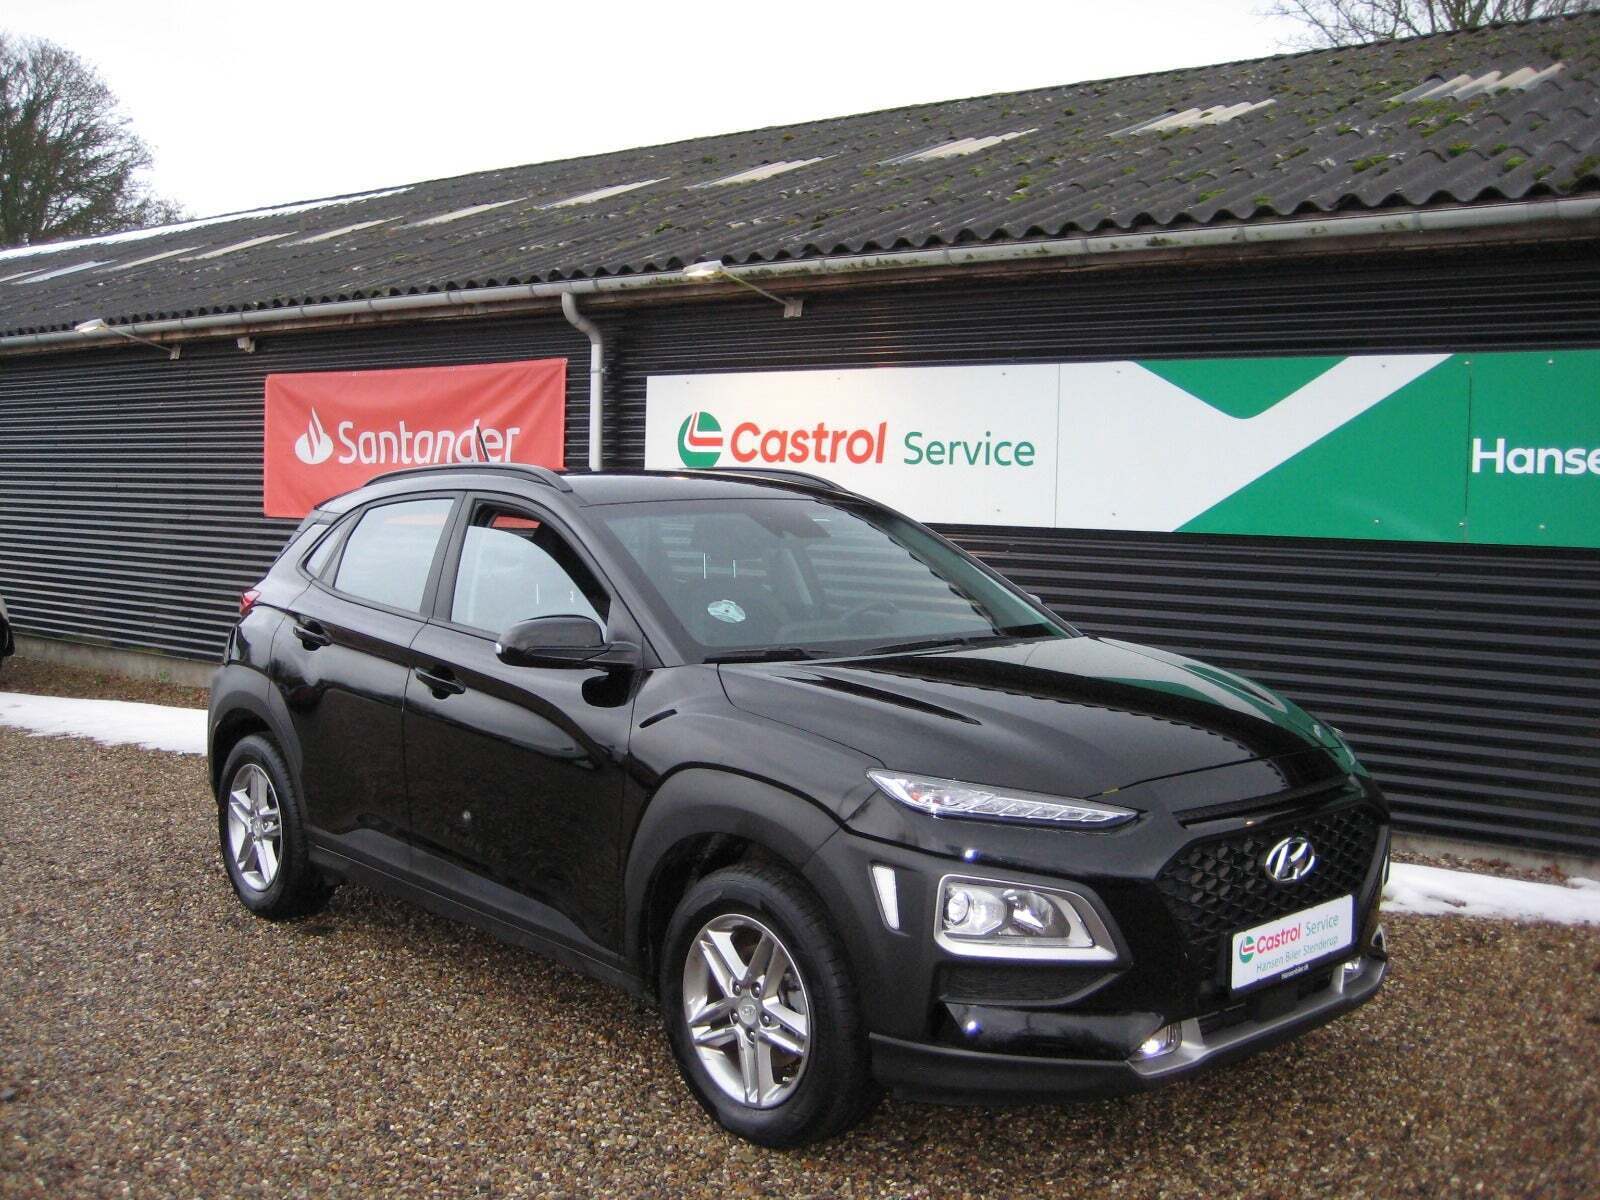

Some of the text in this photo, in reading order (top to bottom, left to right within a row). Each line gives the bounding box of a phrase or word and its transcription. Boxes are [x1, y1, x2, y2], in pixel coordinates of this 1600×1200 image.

[338, 418, 521, 465] Santander
[730, 421, 1035, 467] Castrol Service
[1256, 914, 1340, 954] Castrol Service
[1256, 956, 1284, 974] Hansen
